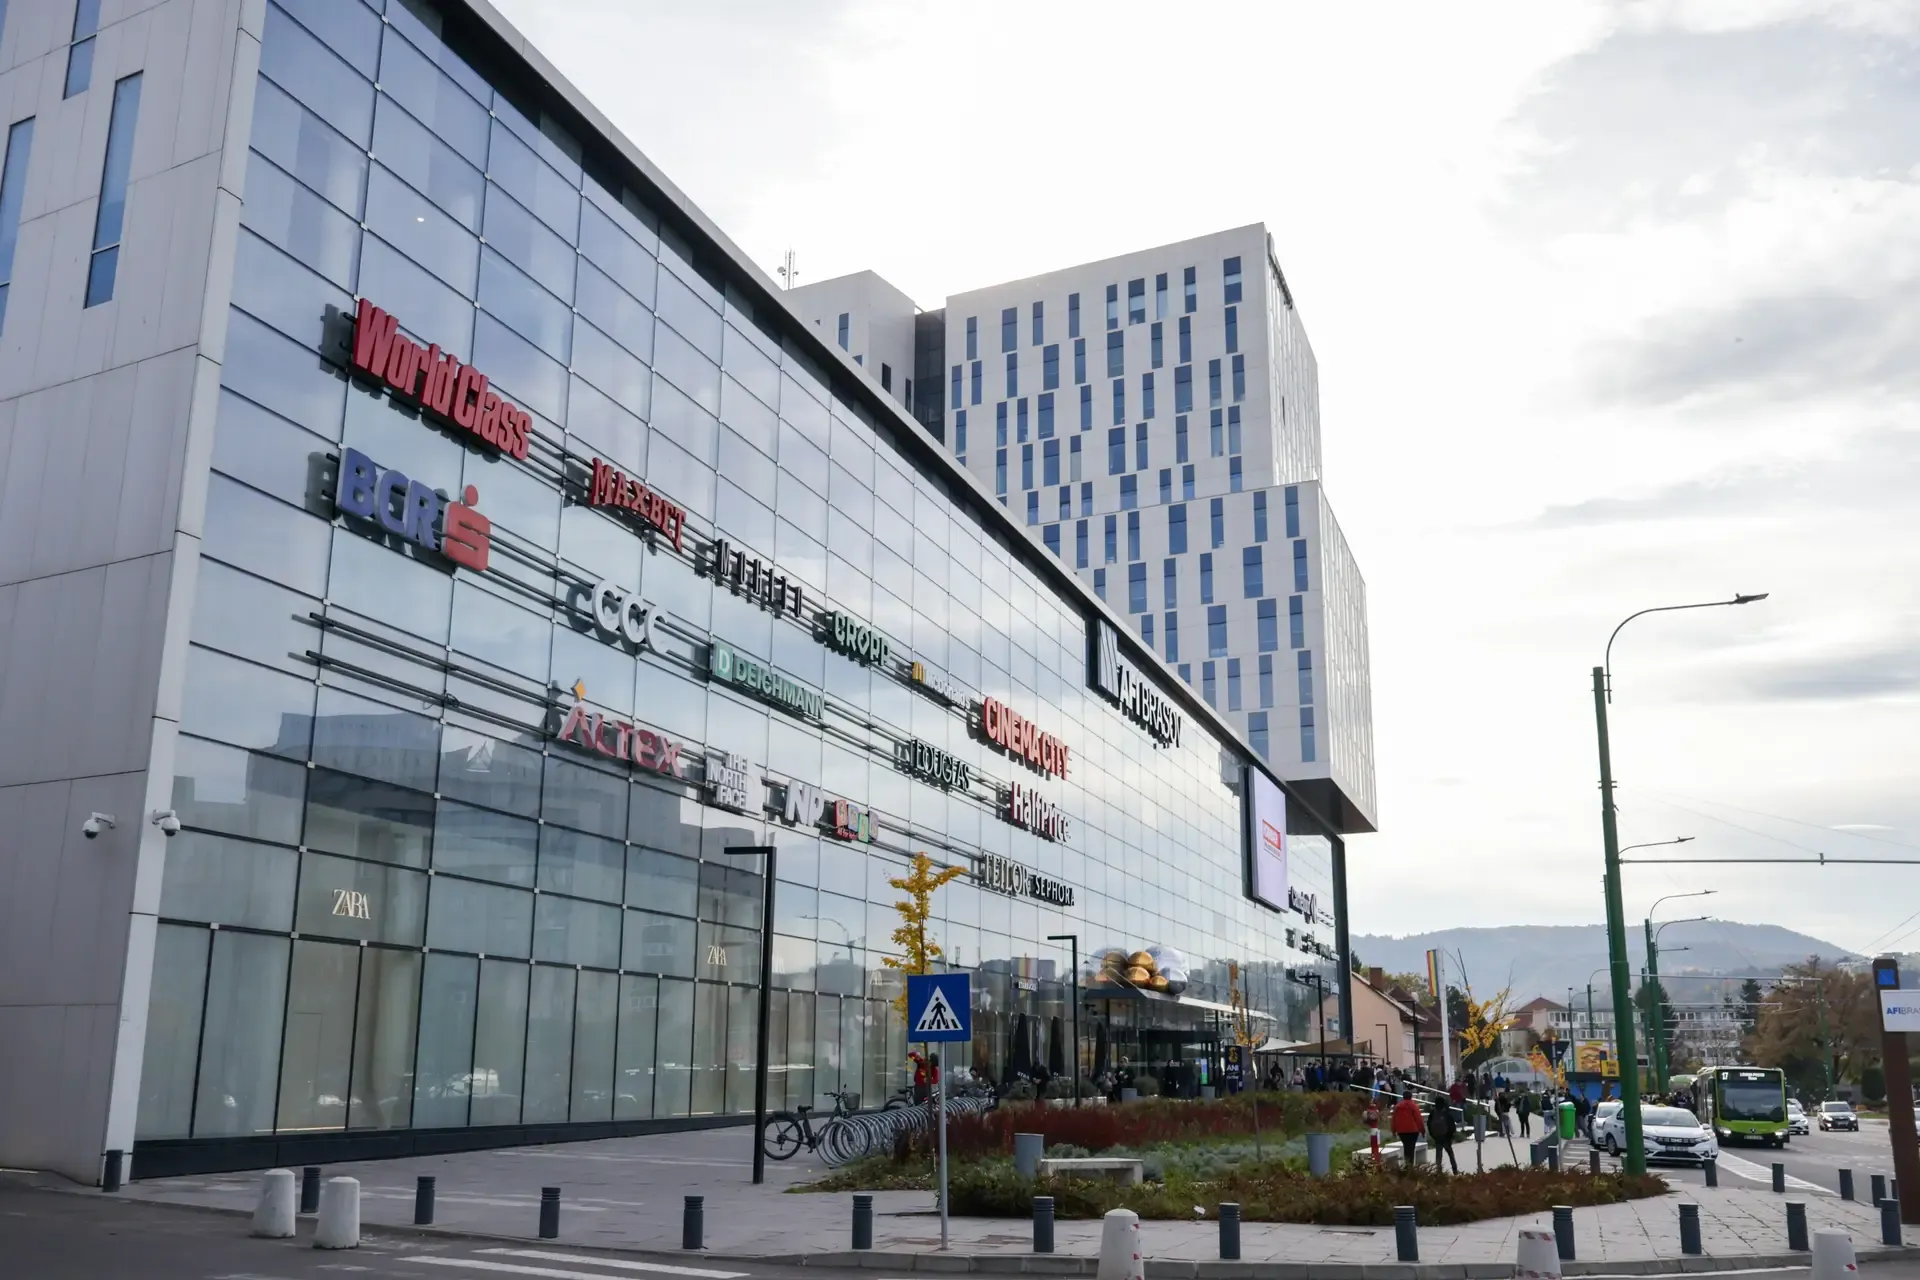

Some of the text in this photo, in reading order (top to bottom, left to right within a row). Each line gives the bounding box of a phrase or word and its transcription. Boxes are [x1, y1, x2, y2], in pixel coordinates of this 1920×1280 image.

[336, 447, 439, 551] BCR
[591, 457, 687, 553] MAXBET
[592, 579, 668, 654] CCC
[834, 610, 891, 666] CROPP
[733, 655, 824, 720] DEICHMANN
[1119, 664, 1142, 716] AFI
[983, 696, 1070, 780] CINEMA CITY
[707, 761, 748, 792] NORTH
[728, 753, 748, 771] THE
[716, 783, 748, 807] FACE
[332, 889, 371, 920] ZARA
[1035, 874, 1075, 906] SEPHORA
[707, 945, 727, 966] ZARA
[1721, 1072, 1729, 1080] 17
